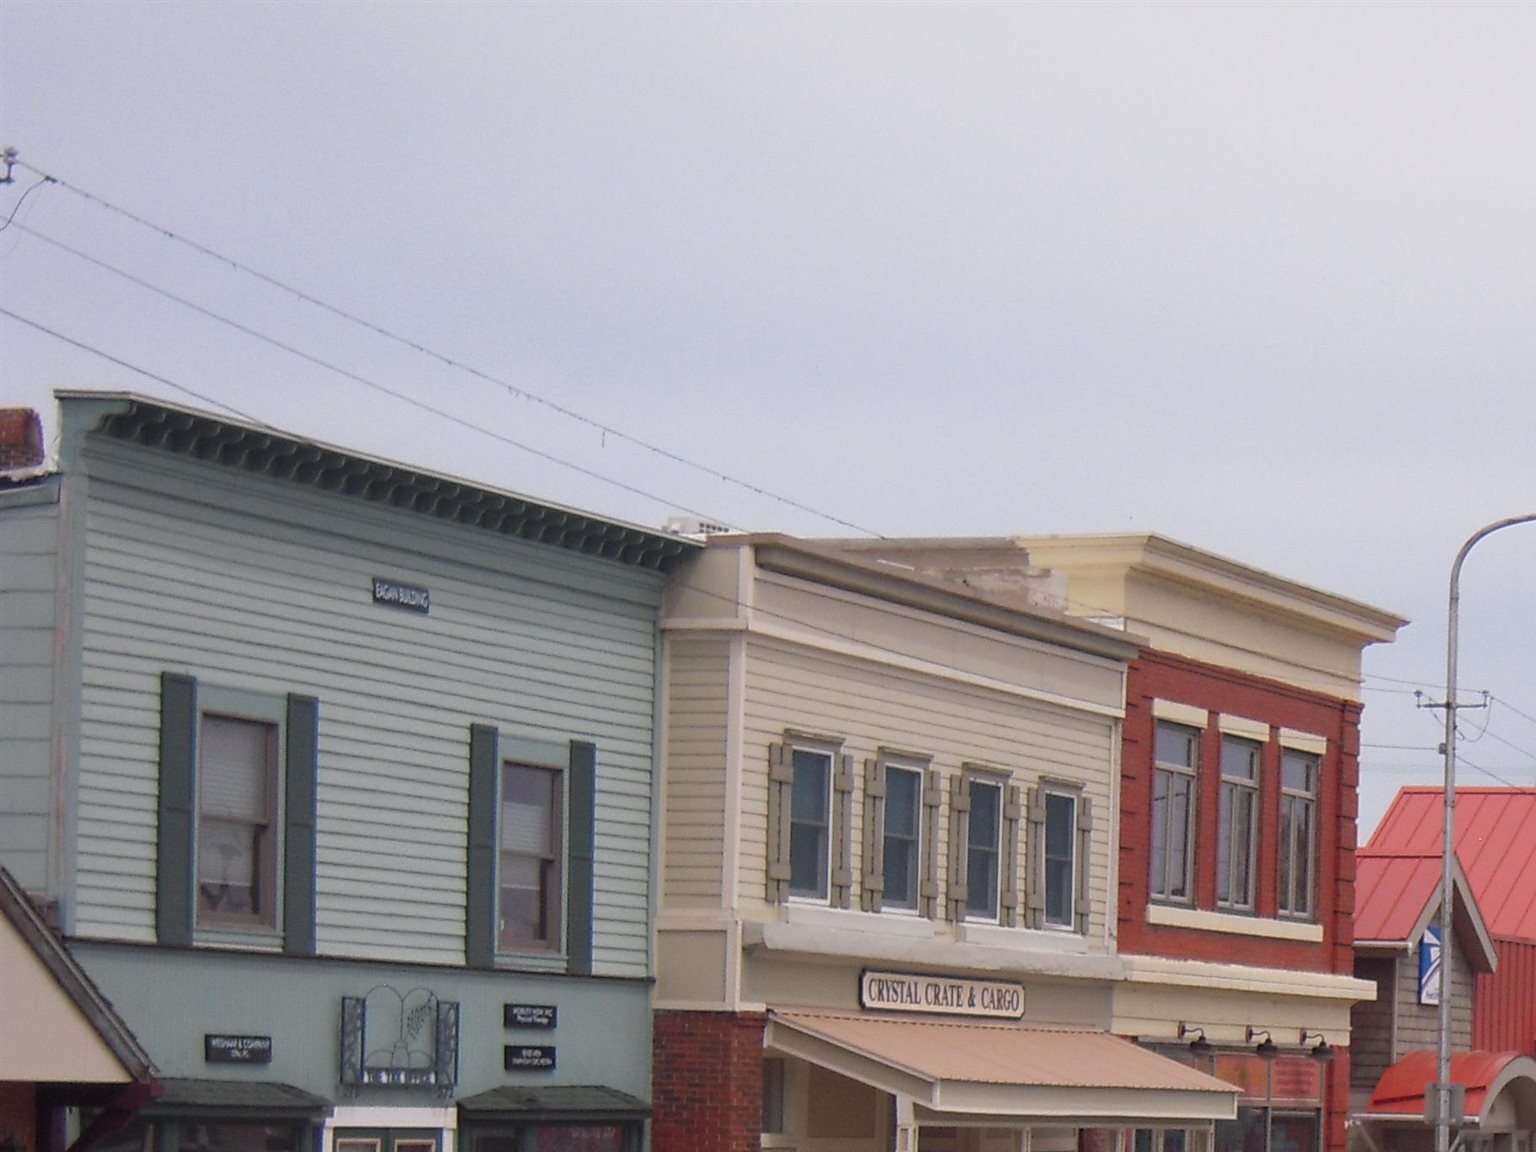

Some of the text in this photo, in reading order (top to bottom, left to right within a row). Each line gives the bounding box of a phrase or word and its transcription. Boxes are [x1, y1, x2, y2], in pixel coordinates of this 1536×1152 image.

[399, 587, 428, 608] BUILDING
[868, 978, 1020, 1012] CRYSTAL CRATE & CARGO
